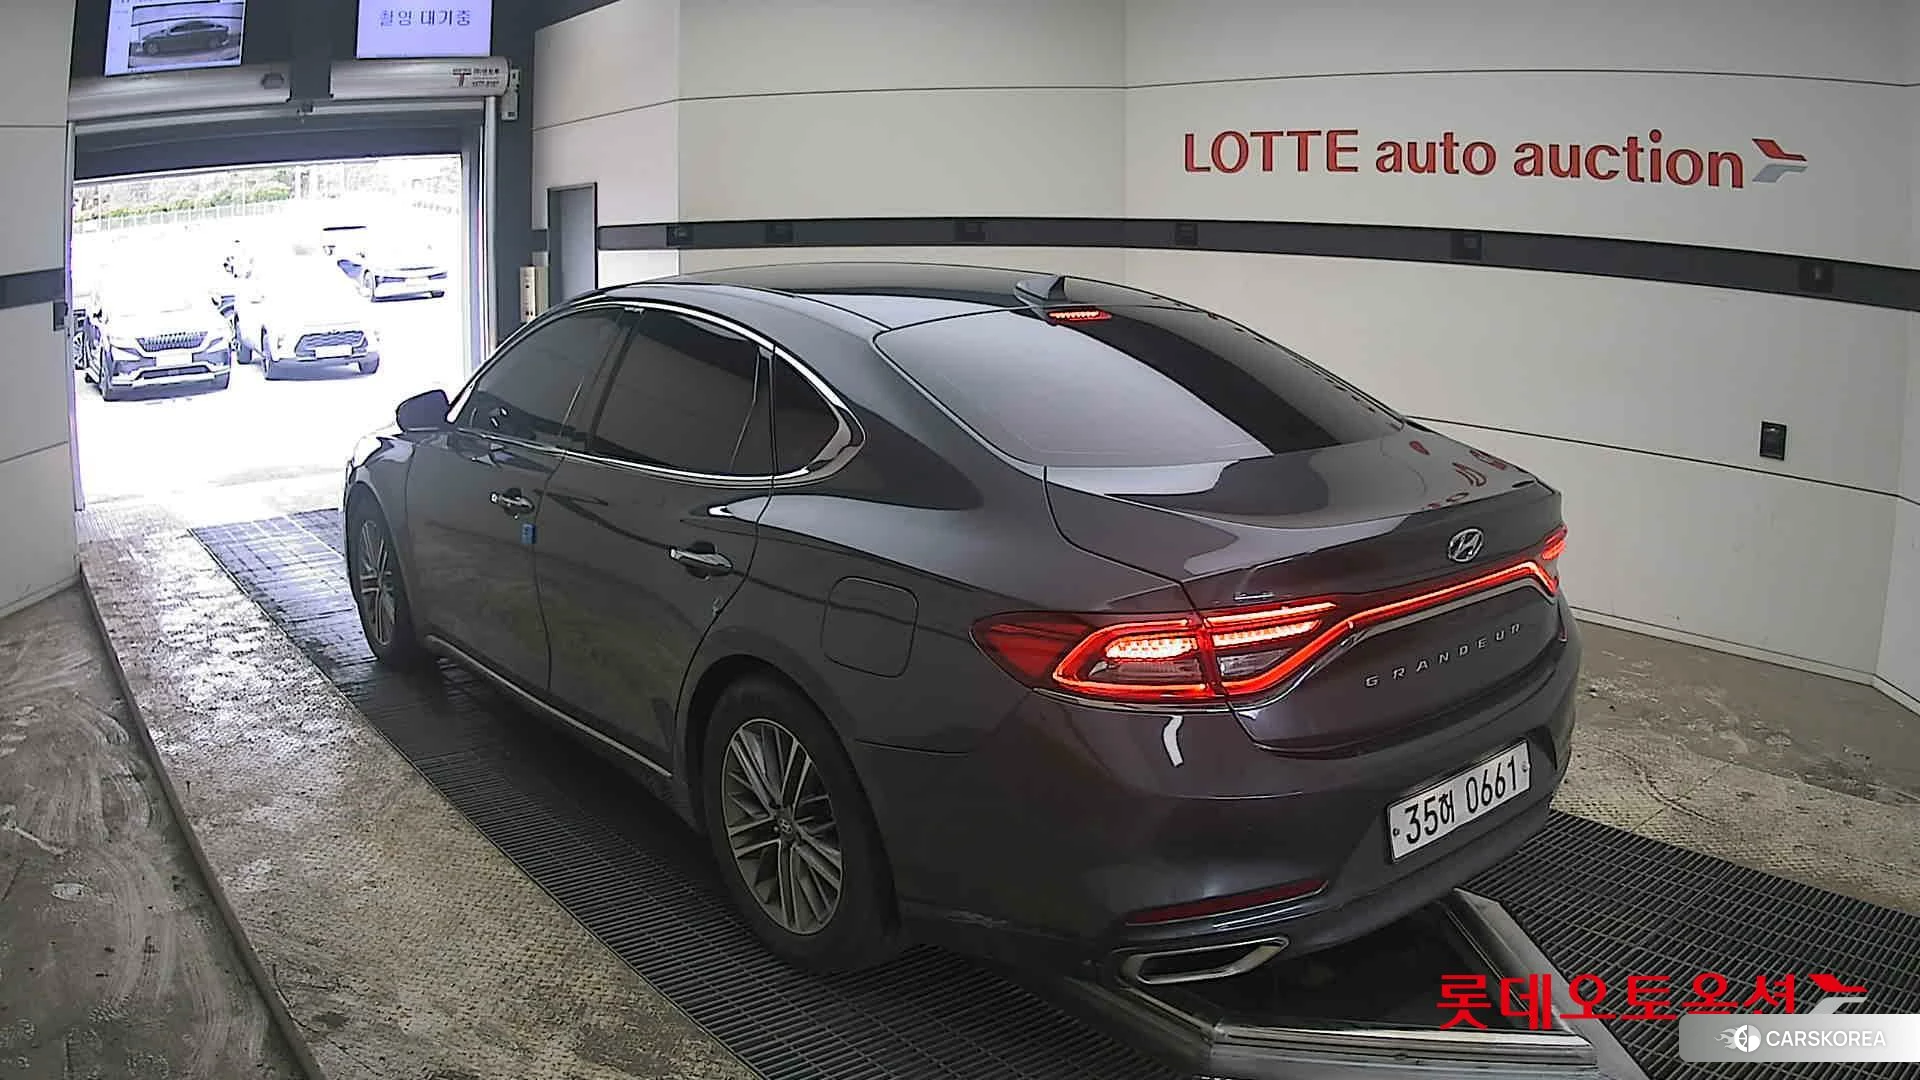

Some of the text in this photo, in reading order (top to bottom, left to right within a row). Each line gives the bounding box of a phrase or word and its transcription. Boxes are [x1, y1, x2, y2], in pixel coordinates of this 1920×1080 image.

[420, 9, 471, 26] 대기중
[1184, 129, 1744, 189] LOTTE auto auction
[1365, 623, 1521, 688] GRANDEUR
[1404, 755, 1517, 844] 35허 0661
